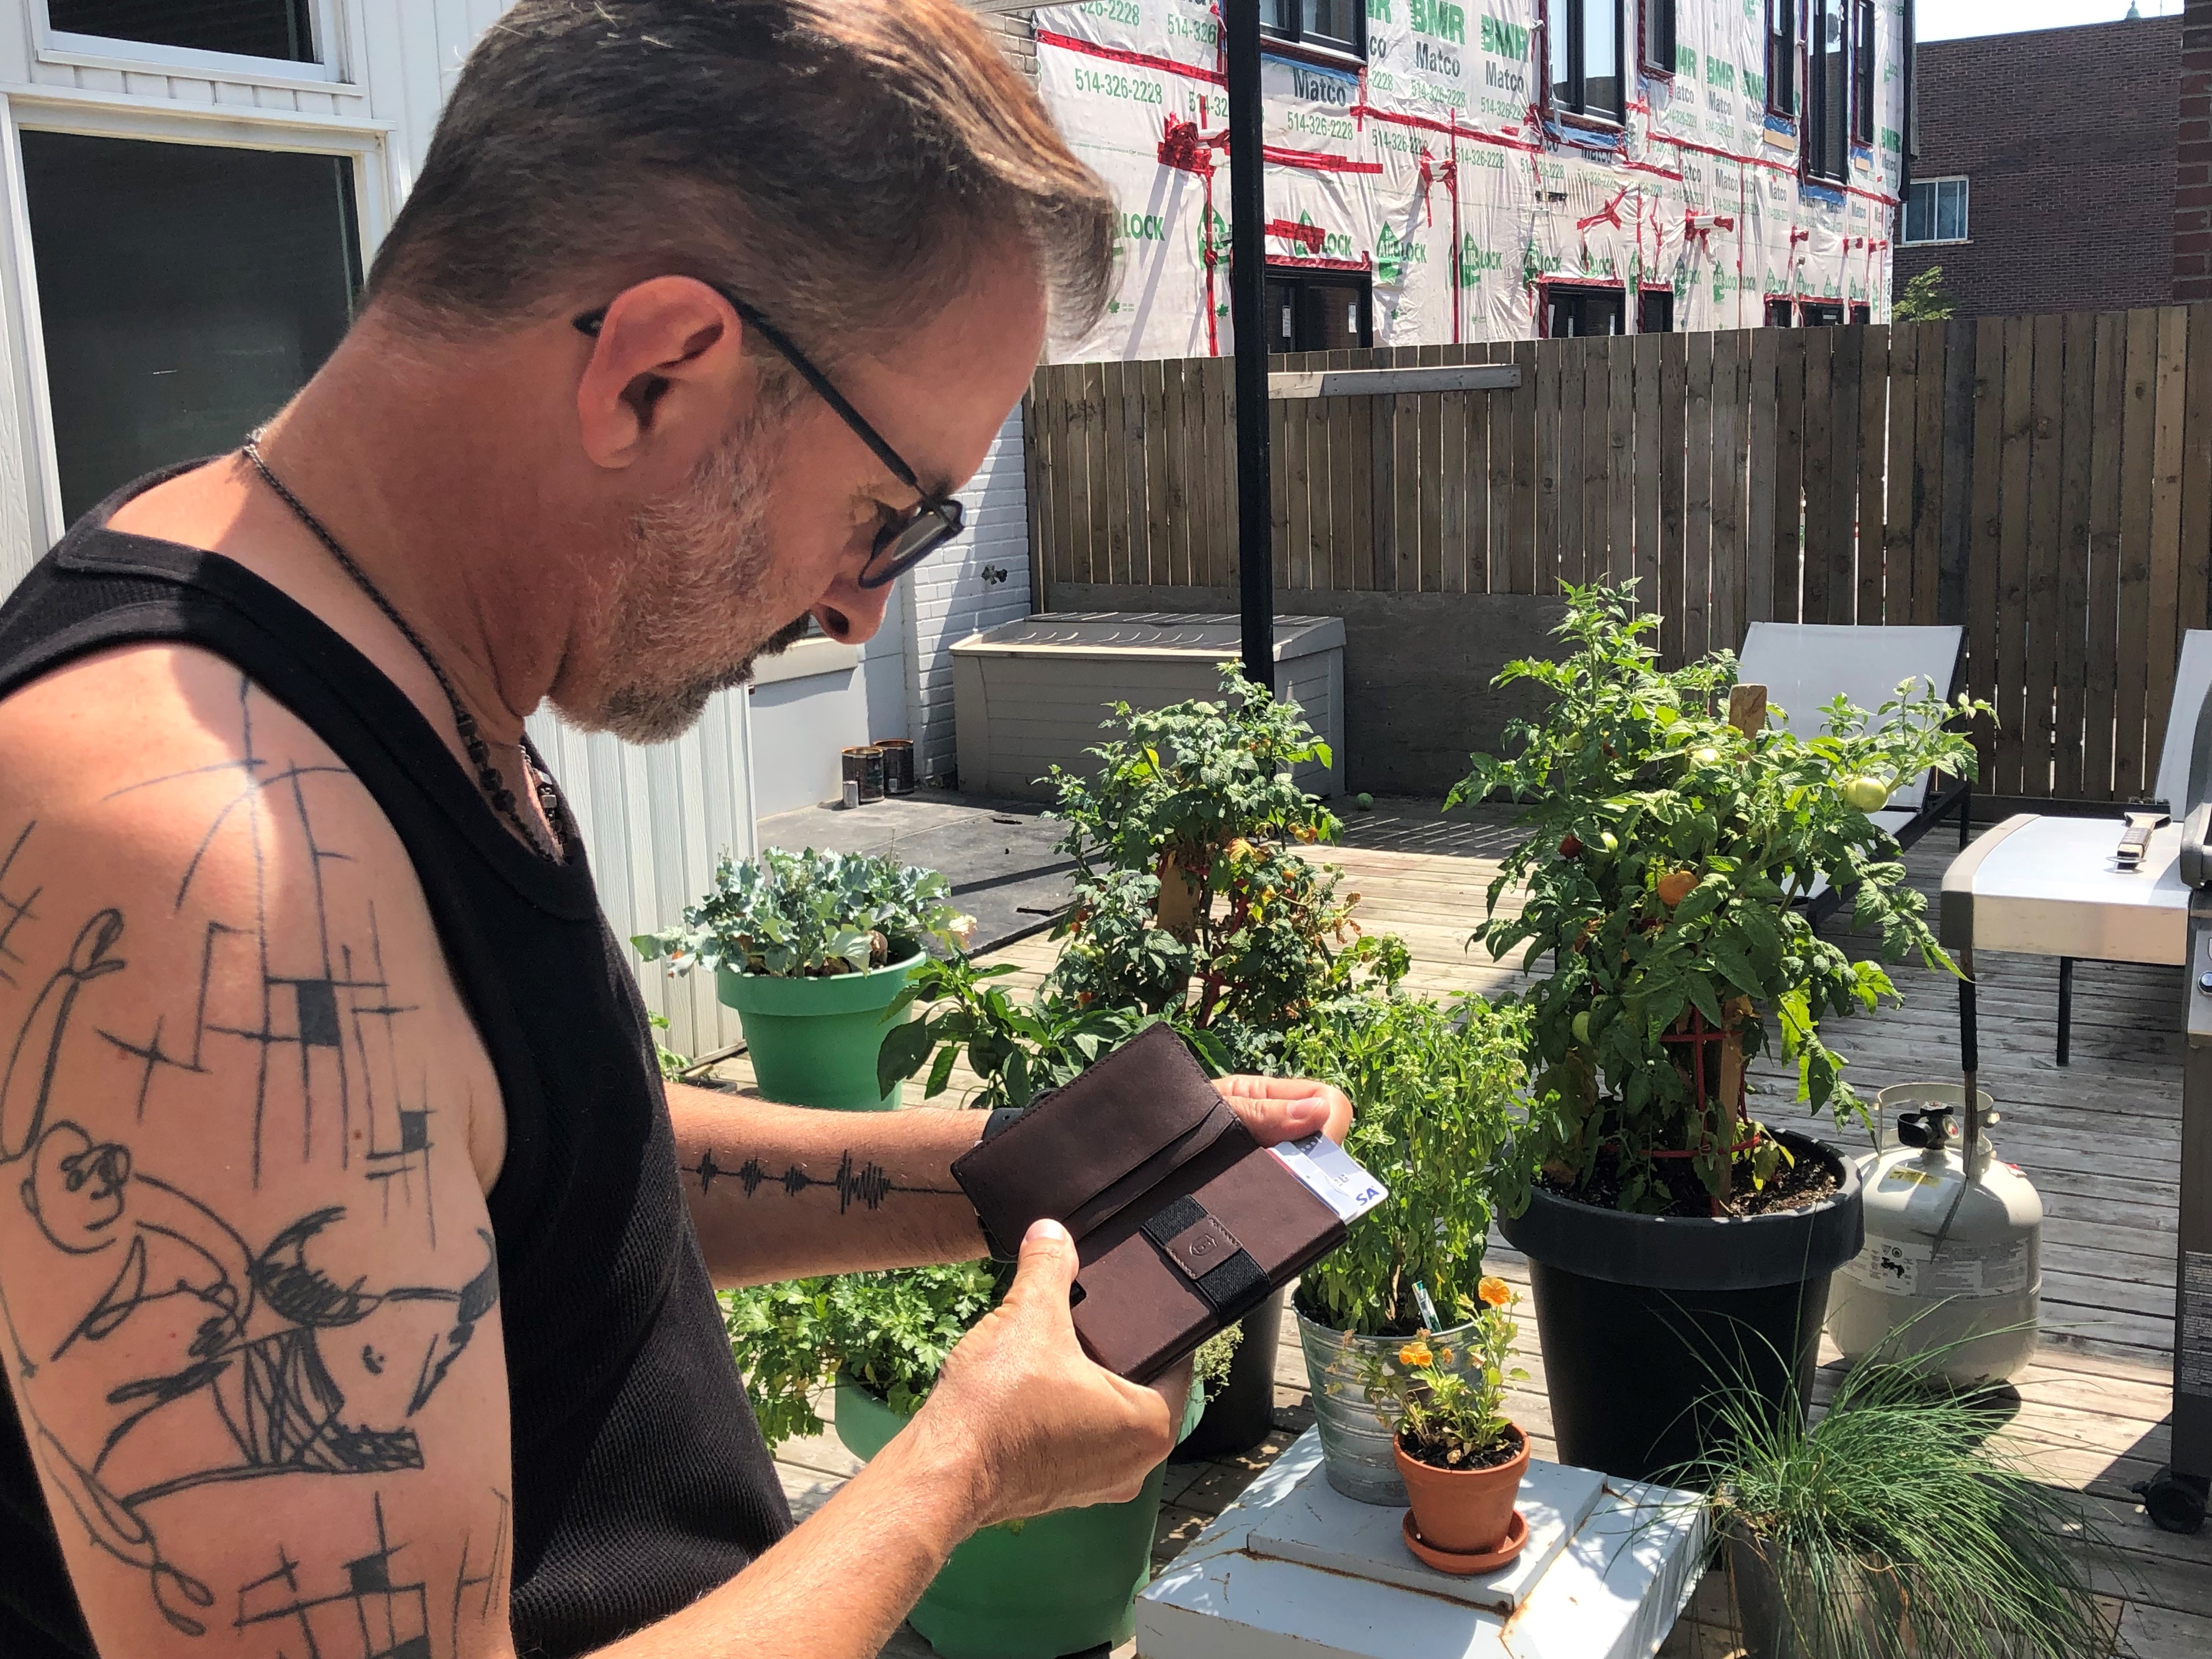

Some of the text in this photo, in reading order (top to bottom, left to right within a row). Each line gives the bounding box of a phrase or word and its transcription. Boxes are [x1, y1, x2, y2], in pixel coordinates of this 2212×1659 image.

[1410, 0, 1465, 45] BMR
[1416, 41, 1460, 77] Matco
[1486, 60, 1525, 94] Matco
[1706, 55, 1734, 92] BMR
[1075, 67, 1162, 104] 514-326-2228
[1293, 66, 1346, 107] Matco
[1708, 90, 1731, 116] Matco
[1288, 111, 1353, 141] 514-326-2228
[1716, 168, 1739, 193] Matco
